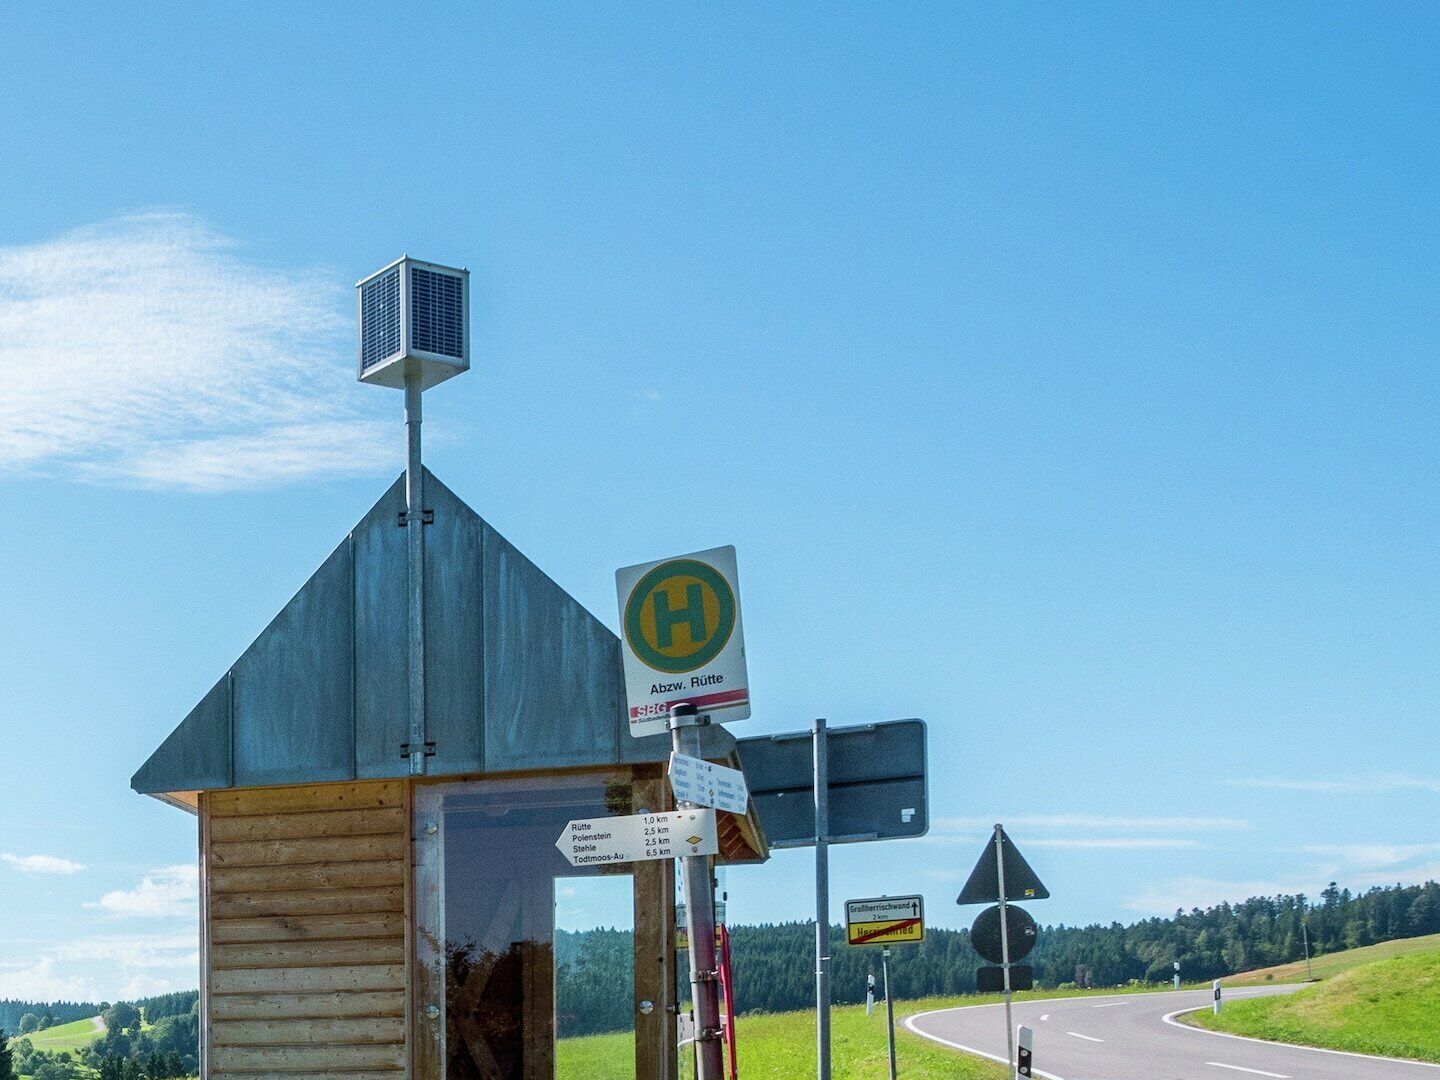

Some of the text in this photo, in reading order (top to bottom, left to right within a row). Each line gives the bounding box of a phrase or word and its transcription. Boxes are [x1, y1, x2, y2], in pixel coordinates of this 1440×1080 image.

[653, 584, 707, 648] H
[650, 674, 724, 695] Abzw. Rütte
[637, 702, 667, 716] SBG
[571, 815, 668, 831] Rütte 1,0 km
[572, 833, 612, 842] Polenstein
[657, 826, 669, 834] km
[573, 837, 670, 853] Stehle 2,5 km
[574, 847, 671, 864] Todtmoos-Au 6,5 km
[850, 902, 910, 913] Großherrischwand
